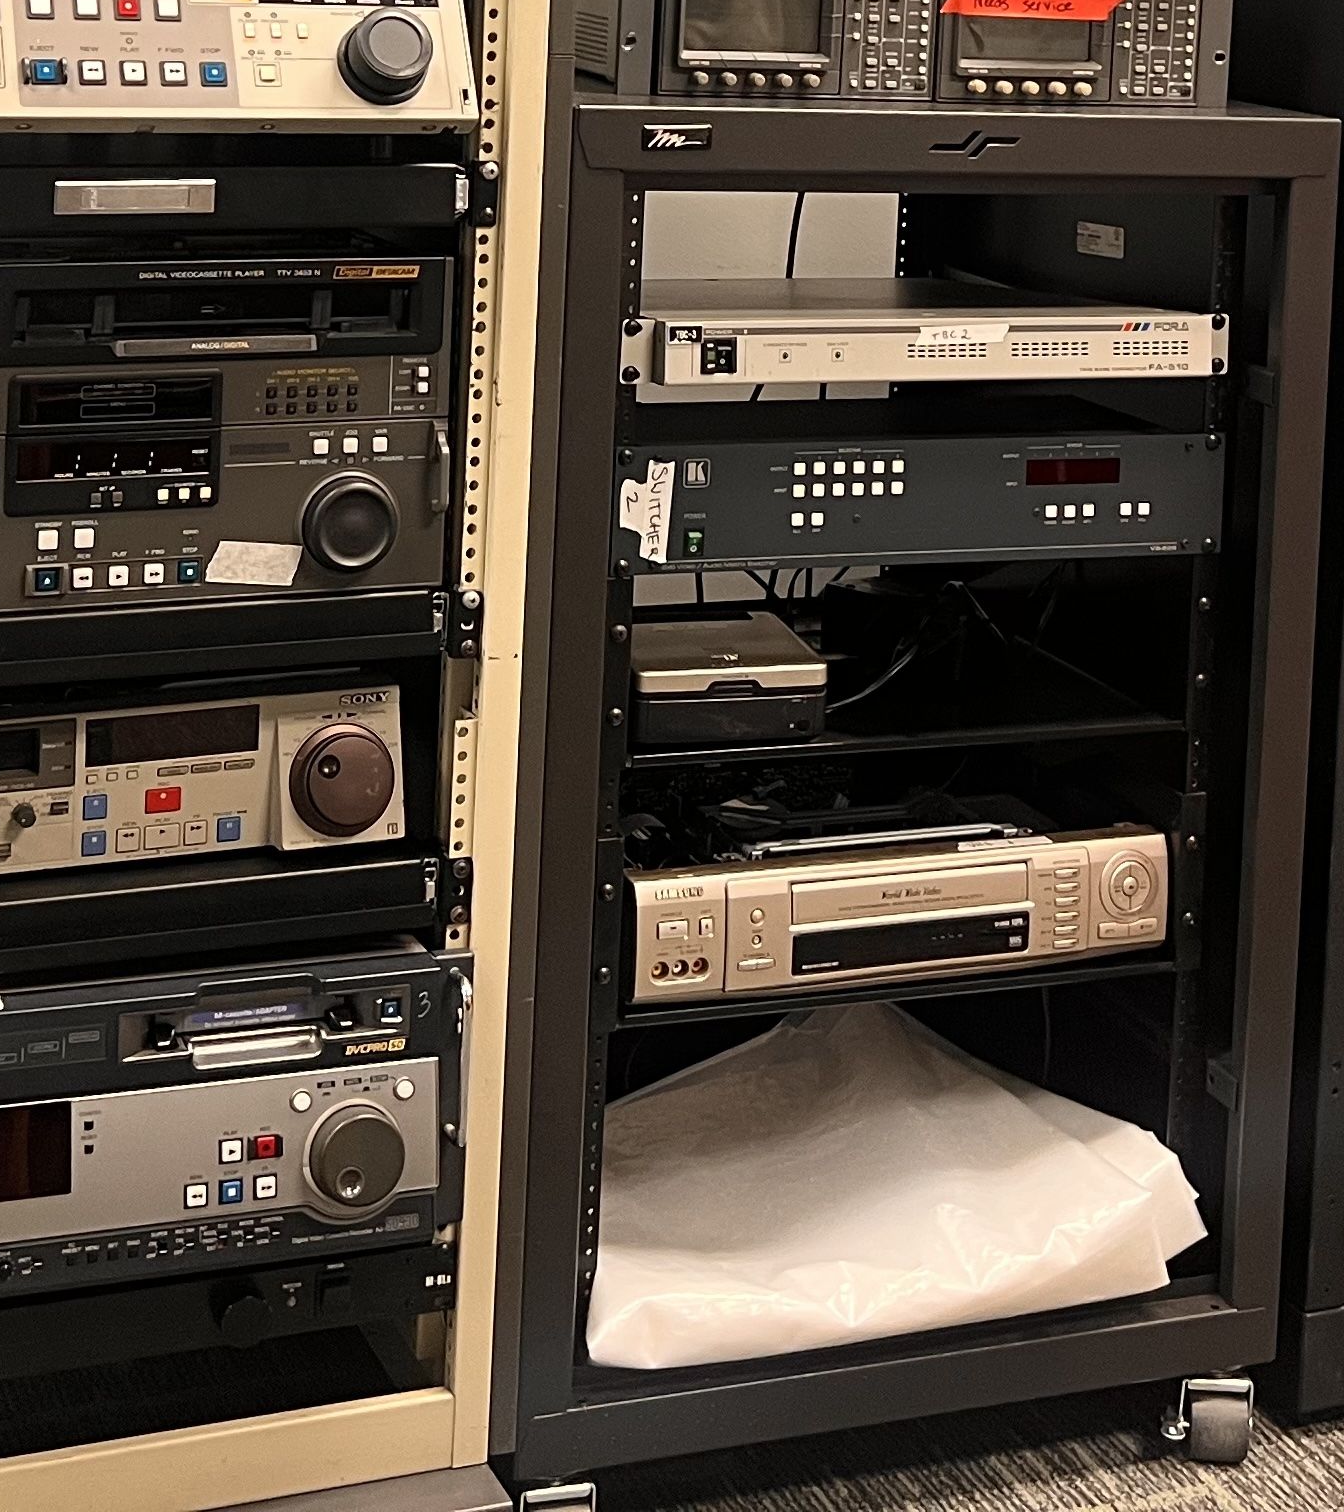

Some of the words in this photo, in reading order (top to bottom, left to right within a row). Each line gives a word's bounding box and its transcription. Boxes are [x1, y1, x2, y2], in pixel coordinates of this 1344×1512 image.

[29, 44, 56, 52] EJECT
[139, 270, 167, 279] DIGITAL
[170, 270, 233, 279] VIDEOCASSETTE
[235, 268, 265, 278] PLAYER
[277, 268, 292, 277] TTV
[339, 268, 370, 277] Digital
[674, 328, 698, 341] TBC-3
[932, 330, 956, 340] TBC
[960, 329, 972, 340] 2
[625, 491, 639, 513] 2
[646, 465, 669, 560] SWITCHER
[182, 546, 198, 554] STOP
[339, 690, 390, 706] SONY
[256, 1005, 288, 1016] ADAPTER
[417, 991, 432, 1018] 3
[345, 1041, 388, 1056] DVCPRO
